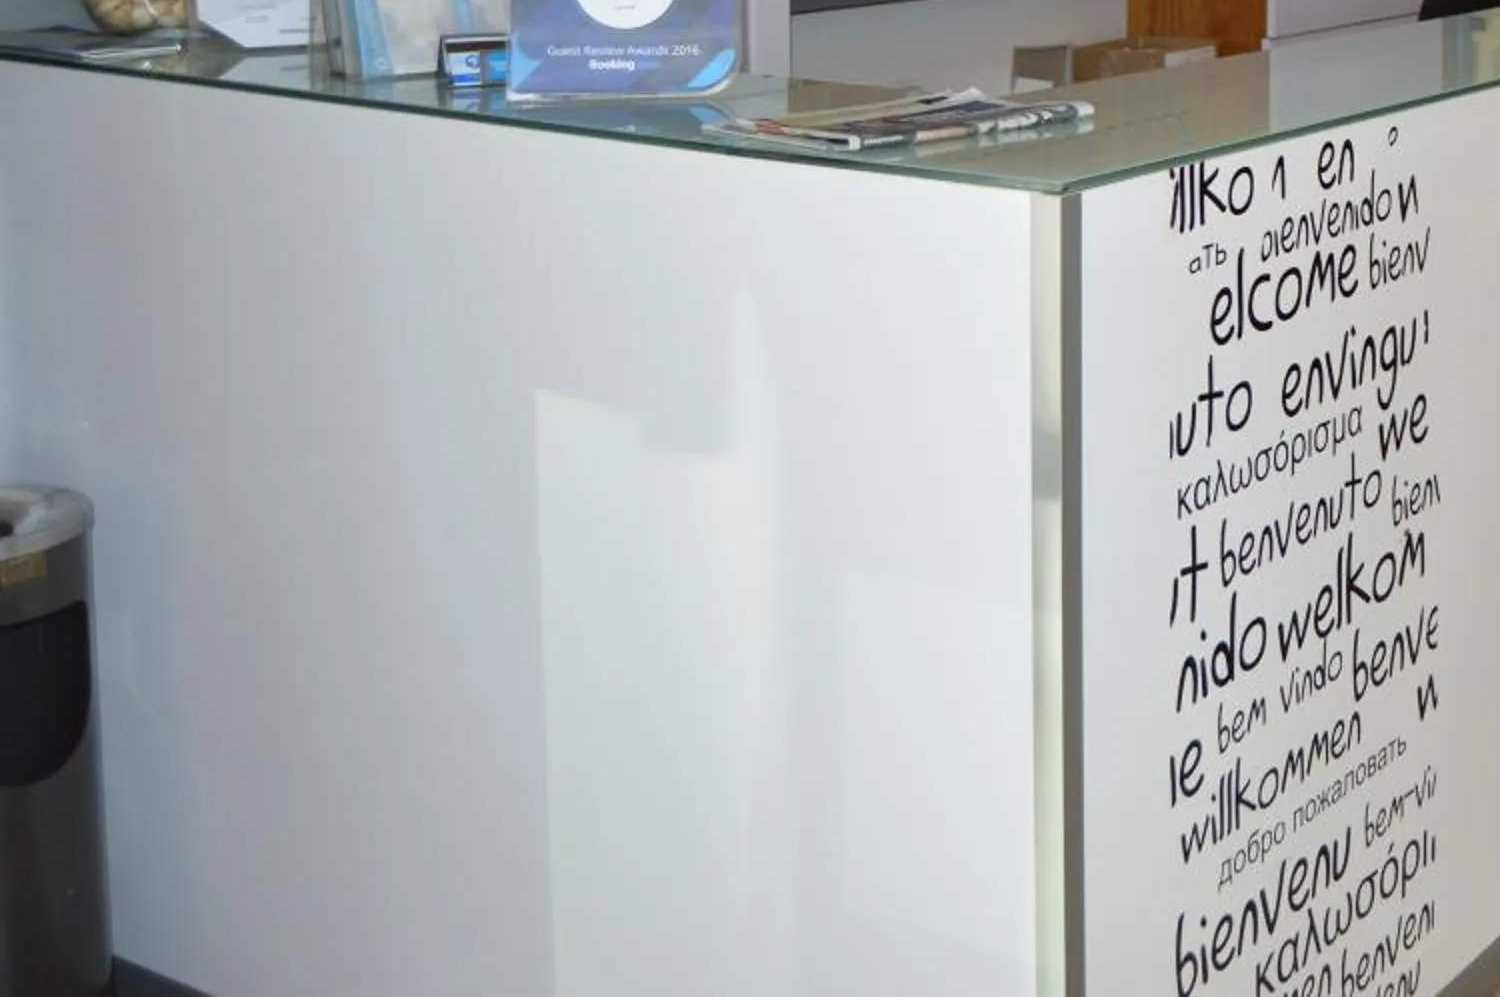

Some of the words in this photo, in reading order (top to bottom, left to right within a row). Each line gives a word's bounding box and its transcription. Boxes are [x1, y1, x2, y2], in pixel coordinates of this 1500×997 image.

[1220, 451, 1382, 588] benvenuto
[1278, 529, 1425, 662] welkom
[1280, 637, 1343, 713] vindo
[1181, 711, 1361, 864] willkommen
